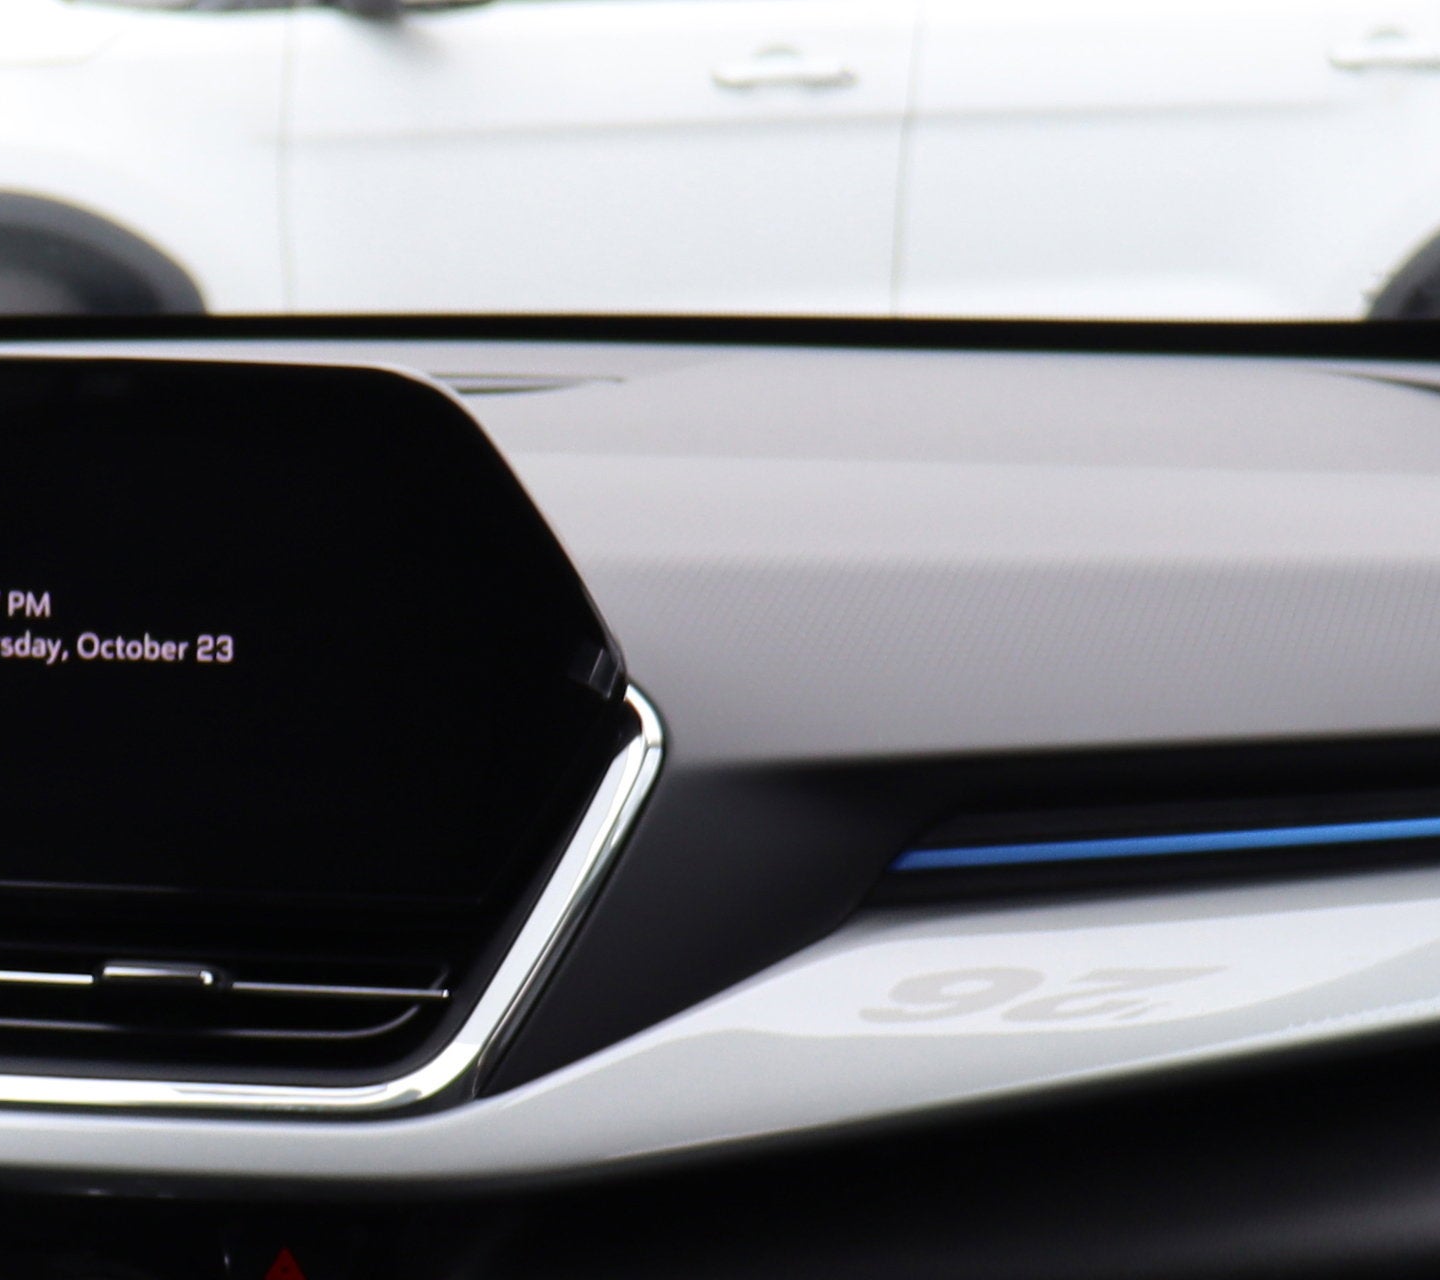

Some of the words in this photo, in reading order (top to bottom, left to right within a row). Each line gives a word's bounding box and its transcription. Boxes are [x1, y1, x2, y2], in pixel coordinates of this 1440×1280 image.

[7, 591, 51, 619] PM
[76, 631, 189, 663] October
[195, 634, 234, 664] 23
